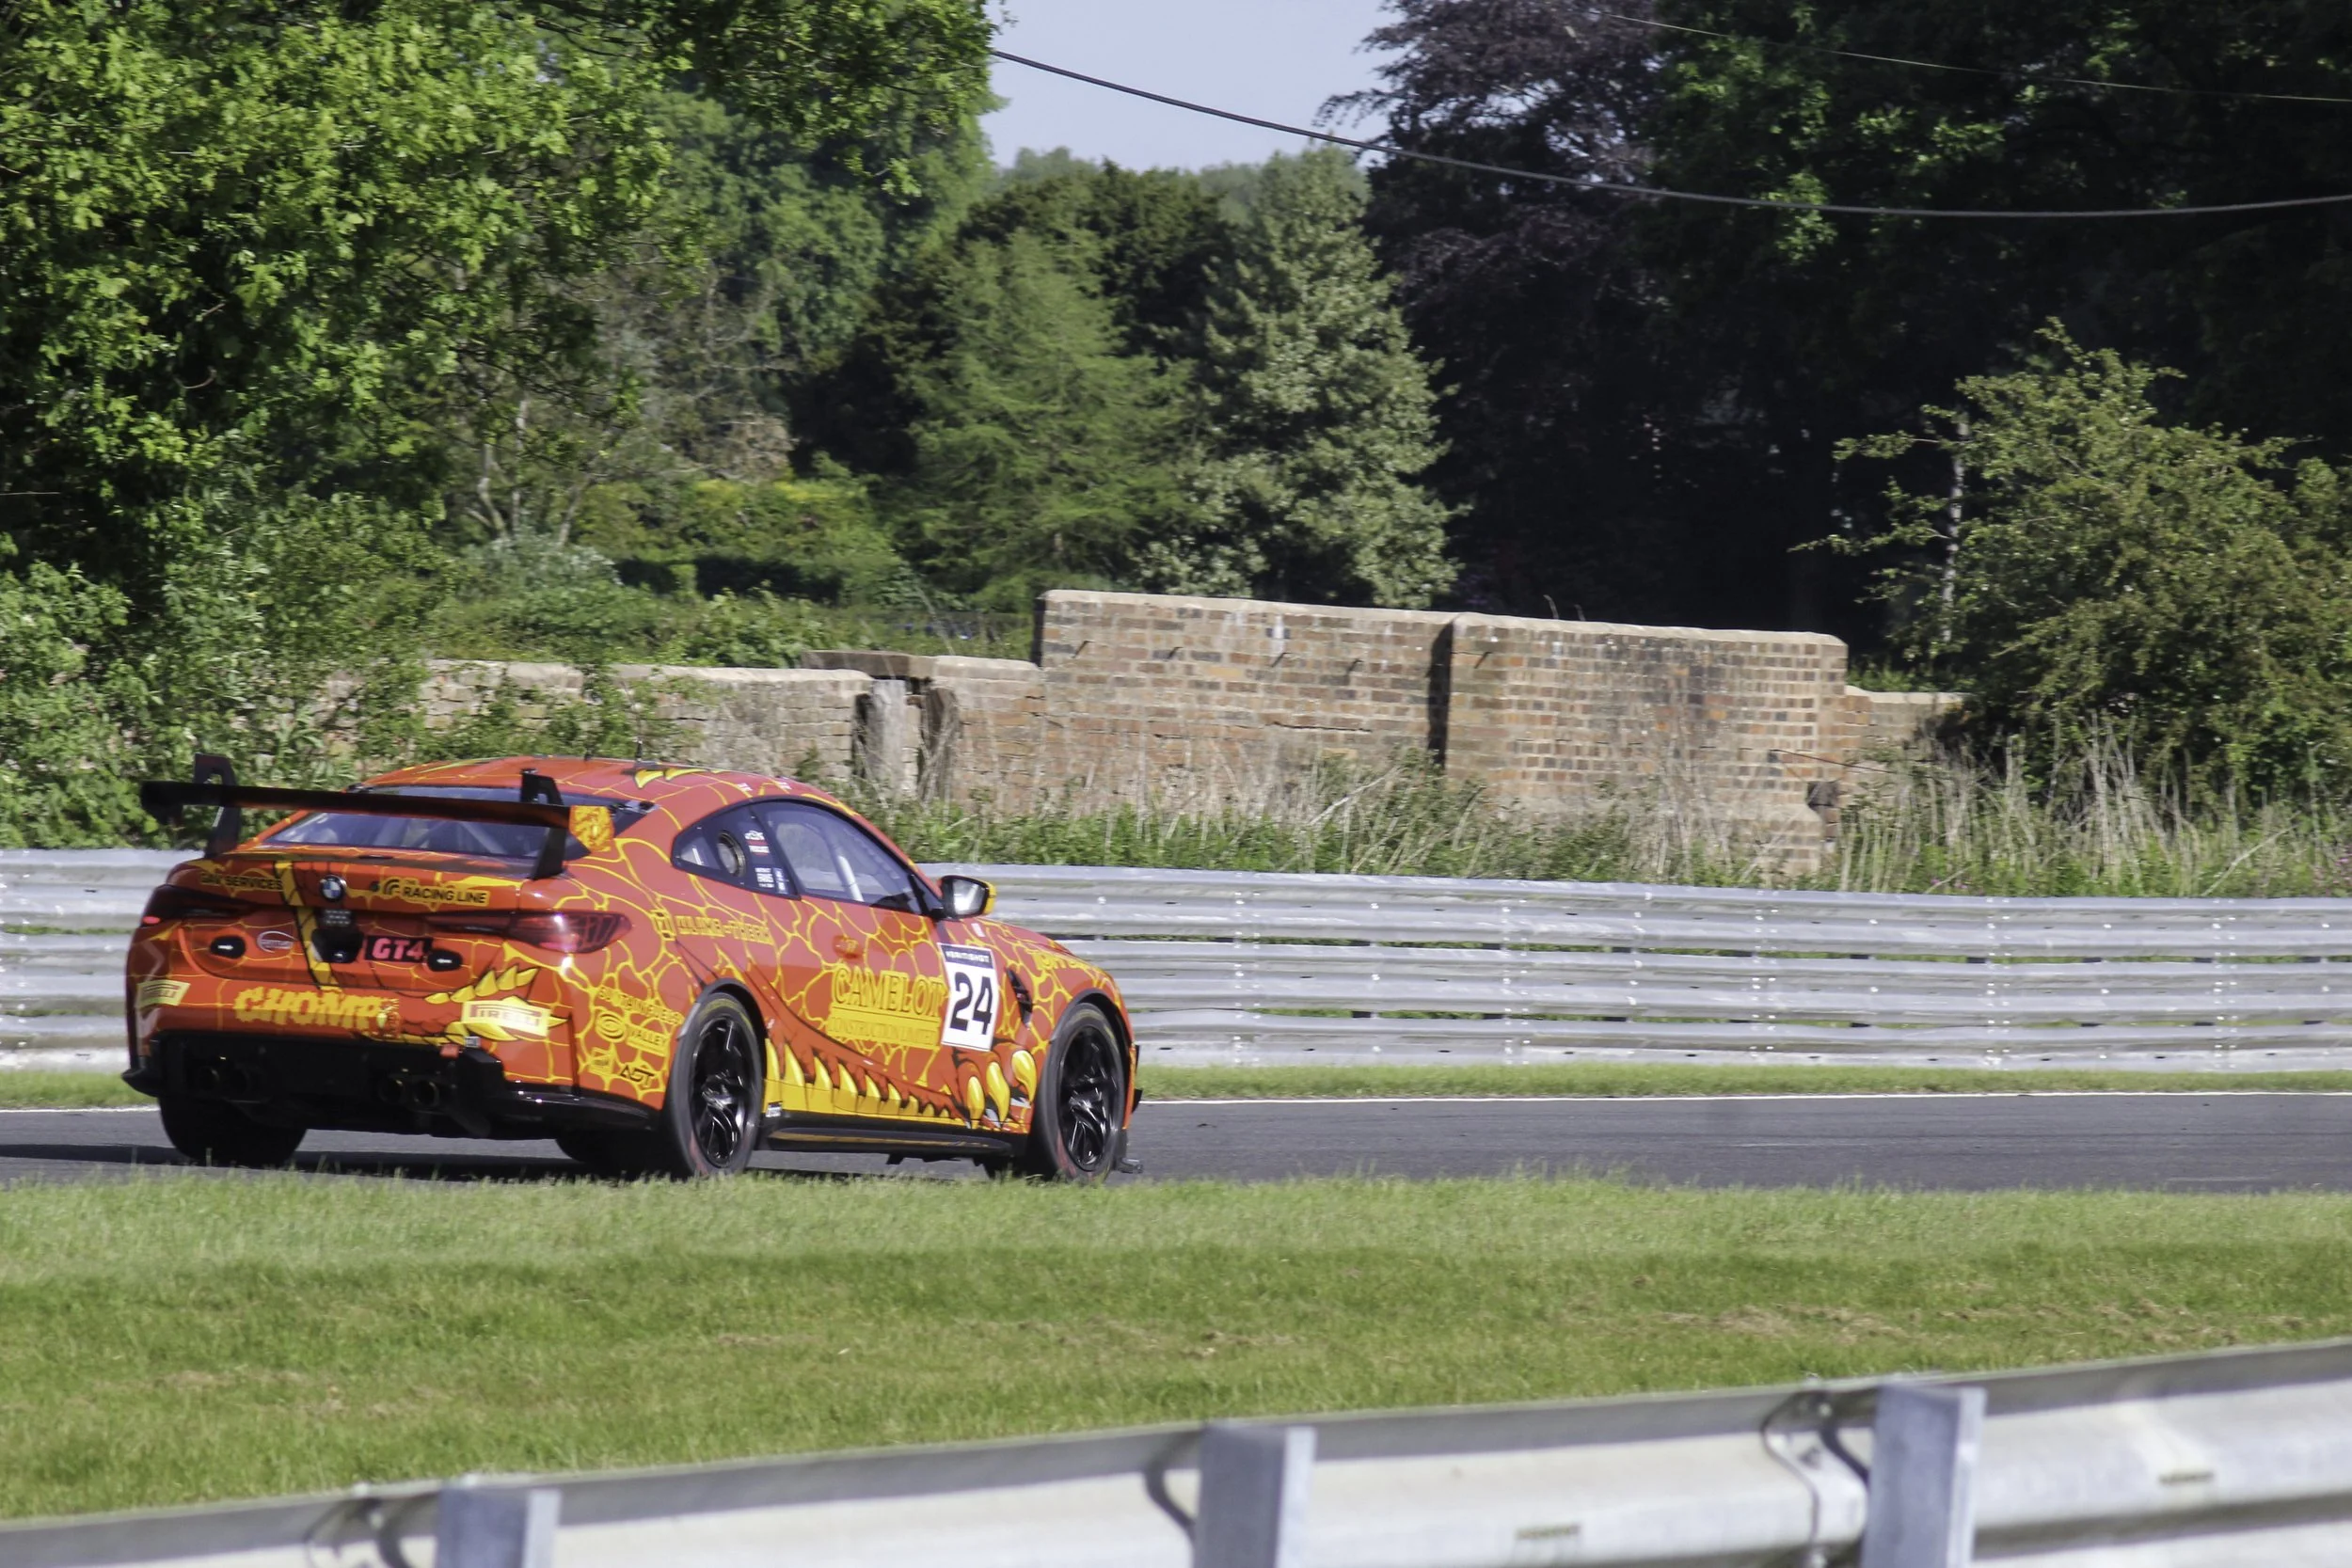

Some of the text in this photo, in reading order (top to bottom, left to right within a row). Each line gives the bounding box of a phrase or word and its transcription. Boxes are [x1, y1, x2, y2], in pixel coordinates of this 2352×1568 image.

[227, 875, 282, 890] SERVICES
[403, 886, 487, 903] RACING LINE
[372, 938, 425, 960] GT4
[834, 967, 946, 1017] CAMELOT
[234, 987, 382, 1029] CHOMP
[470, 1004, 542, 1026] PIRELLI
[949, 972, 993, 1036] 24
